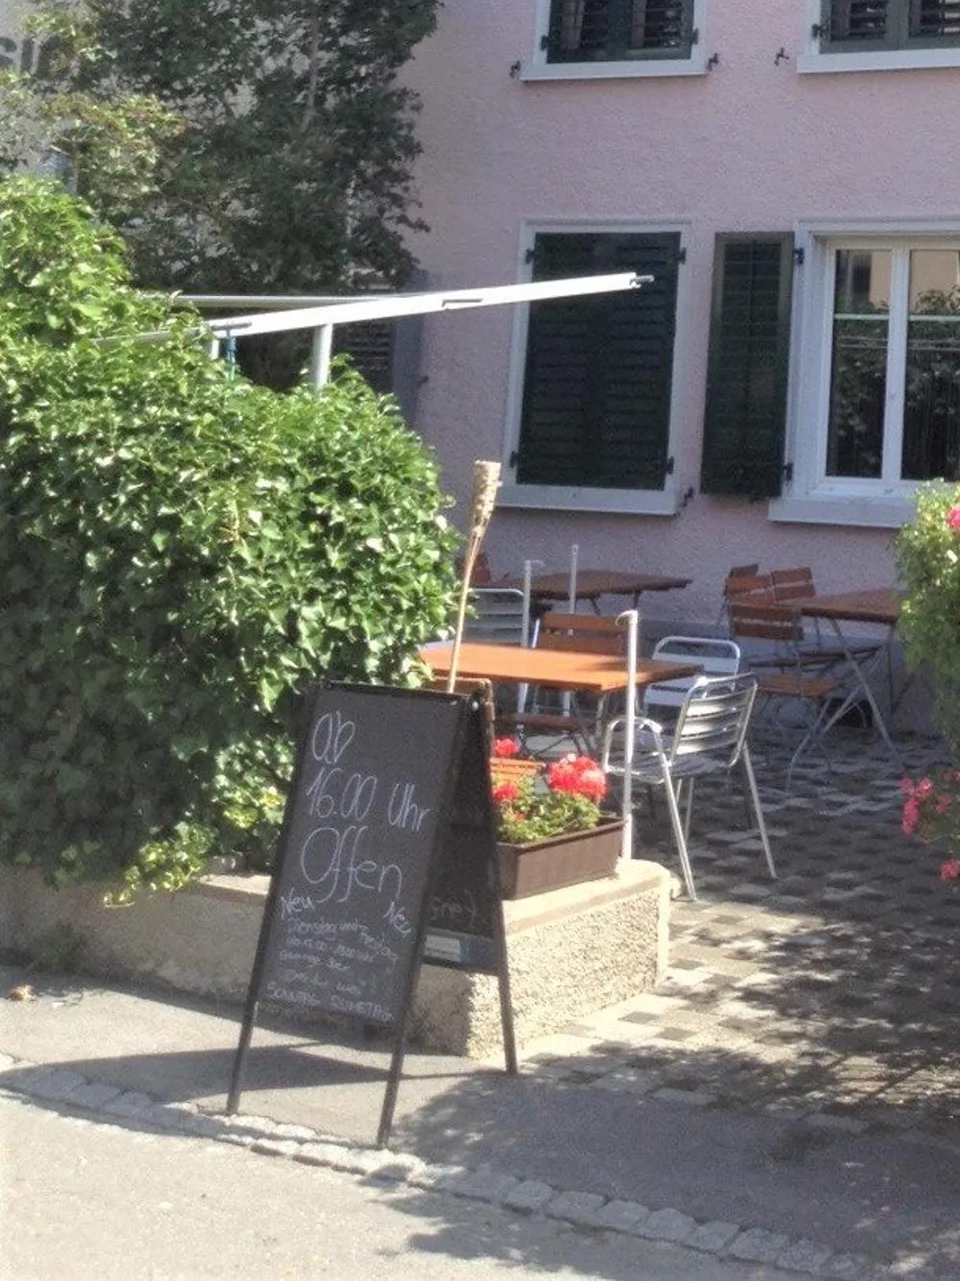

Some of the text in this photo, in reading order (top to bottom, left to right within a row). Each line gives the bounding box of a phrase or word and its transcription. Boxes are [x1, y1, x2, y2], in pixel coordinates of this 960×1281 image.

[306, 766, 430, 831] 16.00 Uhr
[301, 825, 403, 903] Offen
